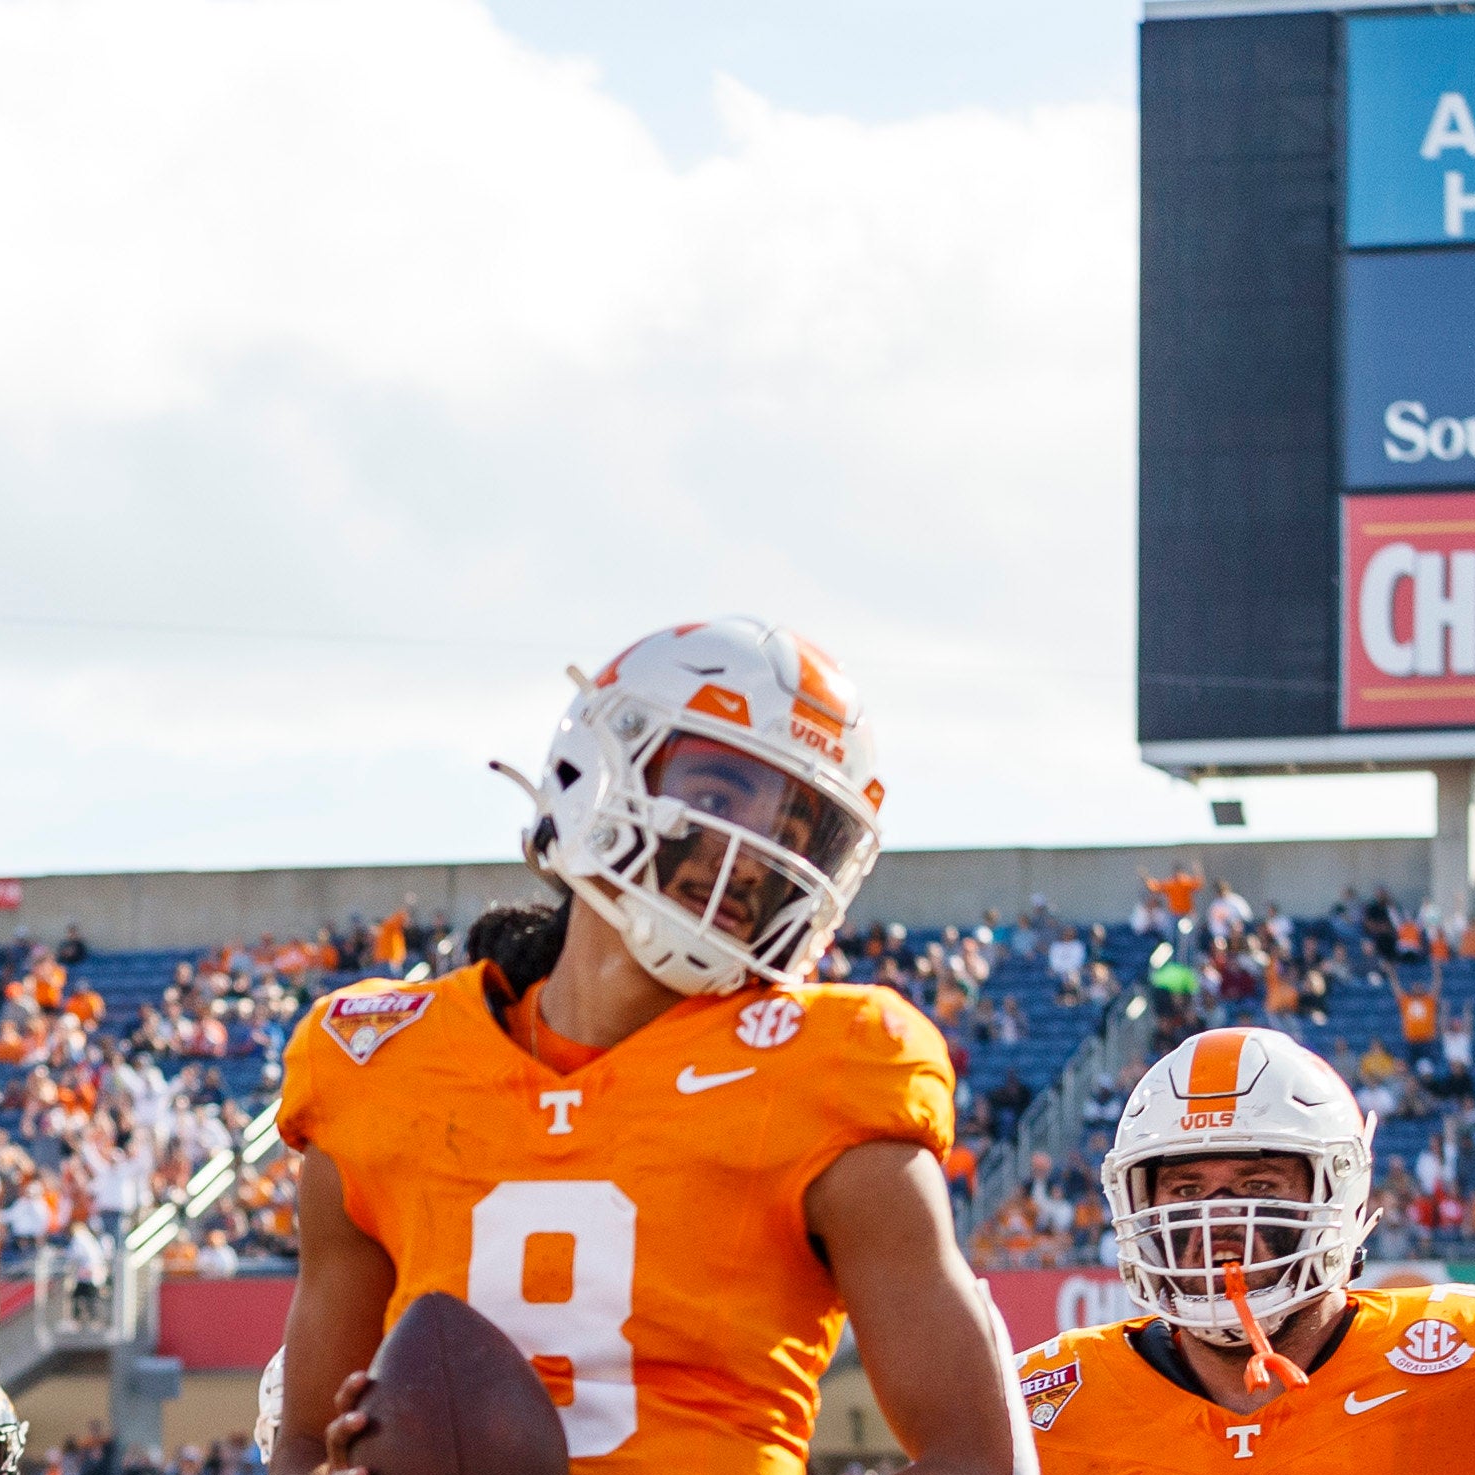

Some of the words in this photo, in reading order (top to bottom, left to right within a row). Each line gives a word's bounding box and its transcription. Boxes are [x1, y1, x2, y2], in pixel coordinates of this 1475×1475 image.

[790, 719, 844, 764] VOLS
[736, 999, 804, 1047] SEC
[539, 1090, 582, 1134] T
[1180, 1112, 1234, 1131] VOLS
[1404, 1319, 1458, 1360] SEC
[1395, 1354, 1462, 1373] GRADUATE
[1226, 1423, 1262, 1460] T
